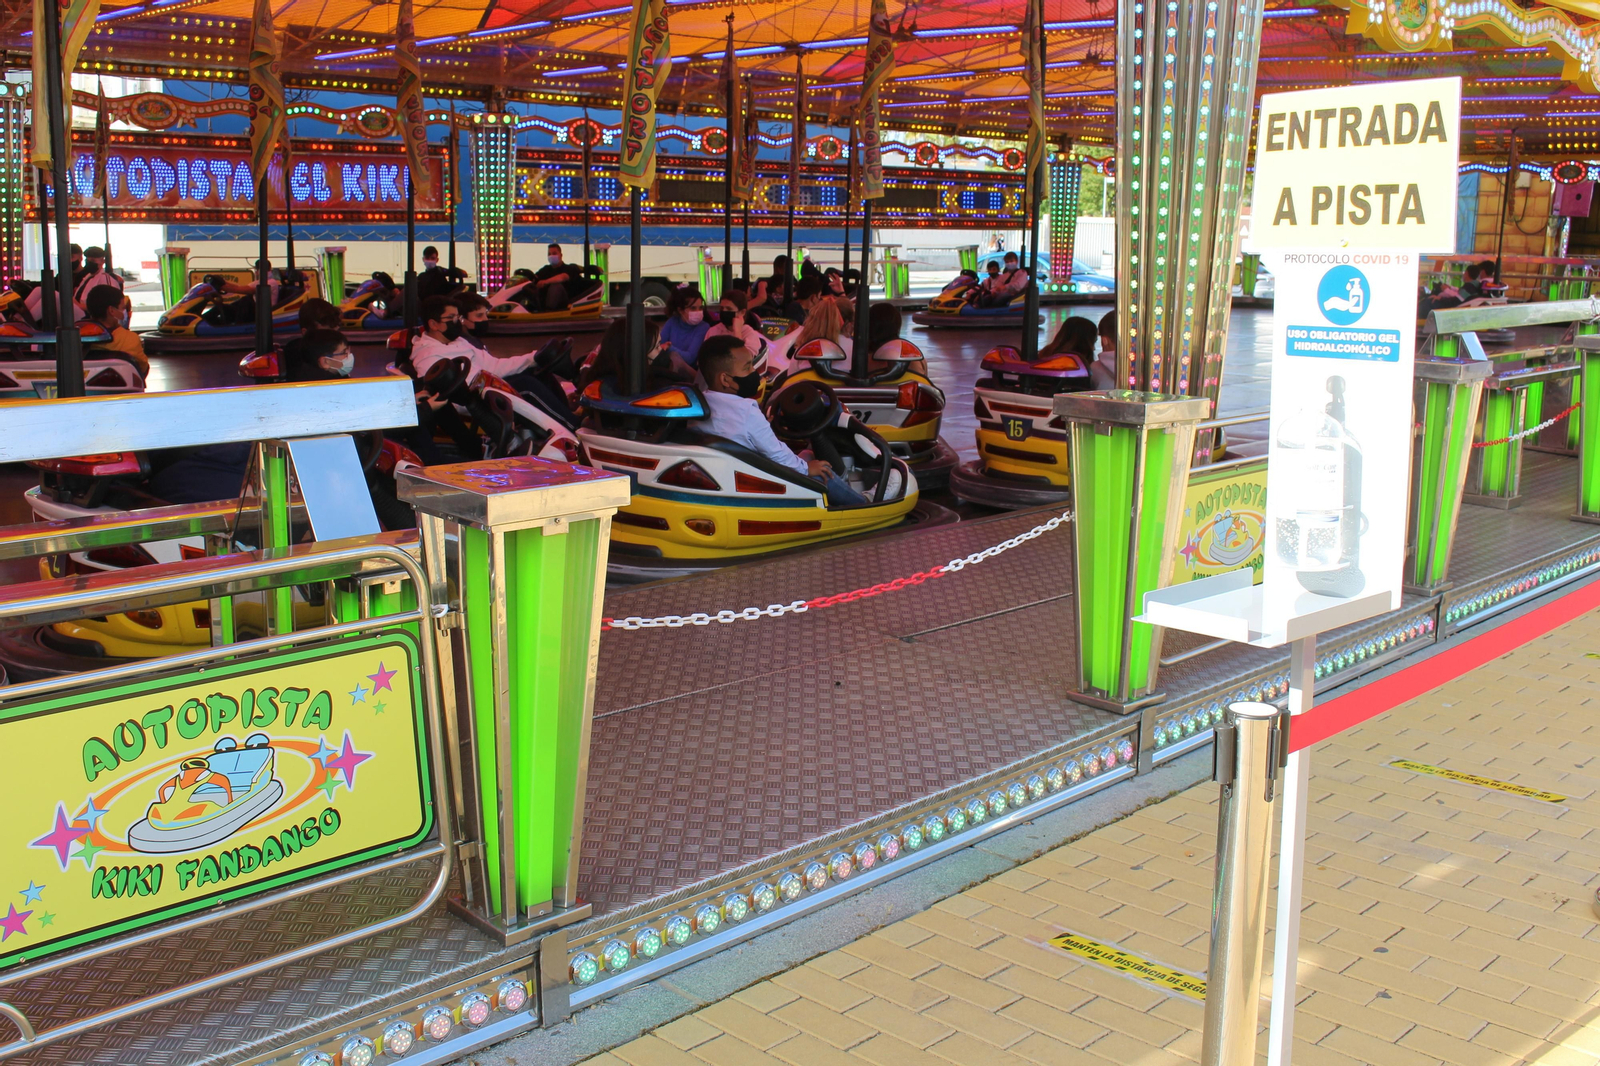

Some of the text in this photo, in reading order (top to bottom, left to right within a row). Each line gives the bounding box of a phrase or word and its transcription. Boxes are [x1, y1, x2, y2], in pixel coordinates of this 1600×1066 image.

[1265, 101, 1447, 152] ENTRADA
[46, 153, 256, 201] UTOPISTA
[291, 162, 331, 201] EL
[1272, 183, 1426, 226] A PISTA
[1284, 253, 1409, 265] PROTOCOLO COVID 19
[767, 326, 780, 335] 22
[1287, 329, 1400, 344] USO OBLIGATORIO GEL
[1293, 341, 1391, 355] HIDROALCOHÓLICO
[1008, 419, 1024, 437] 15
[1195, 482, 1268, 526] AUTOPISTA
[82, 687, 333, 782] AUTOPISTA
[92, 807, 341, 899] KIKI FANDANGO
[1062, 938, 1103, 956] MANTEN
[1100, 952, 1115, 960] LA
[1113, 957, 1166, 980] DISTANCIA
[1166, 976, 1182, 984] DE
